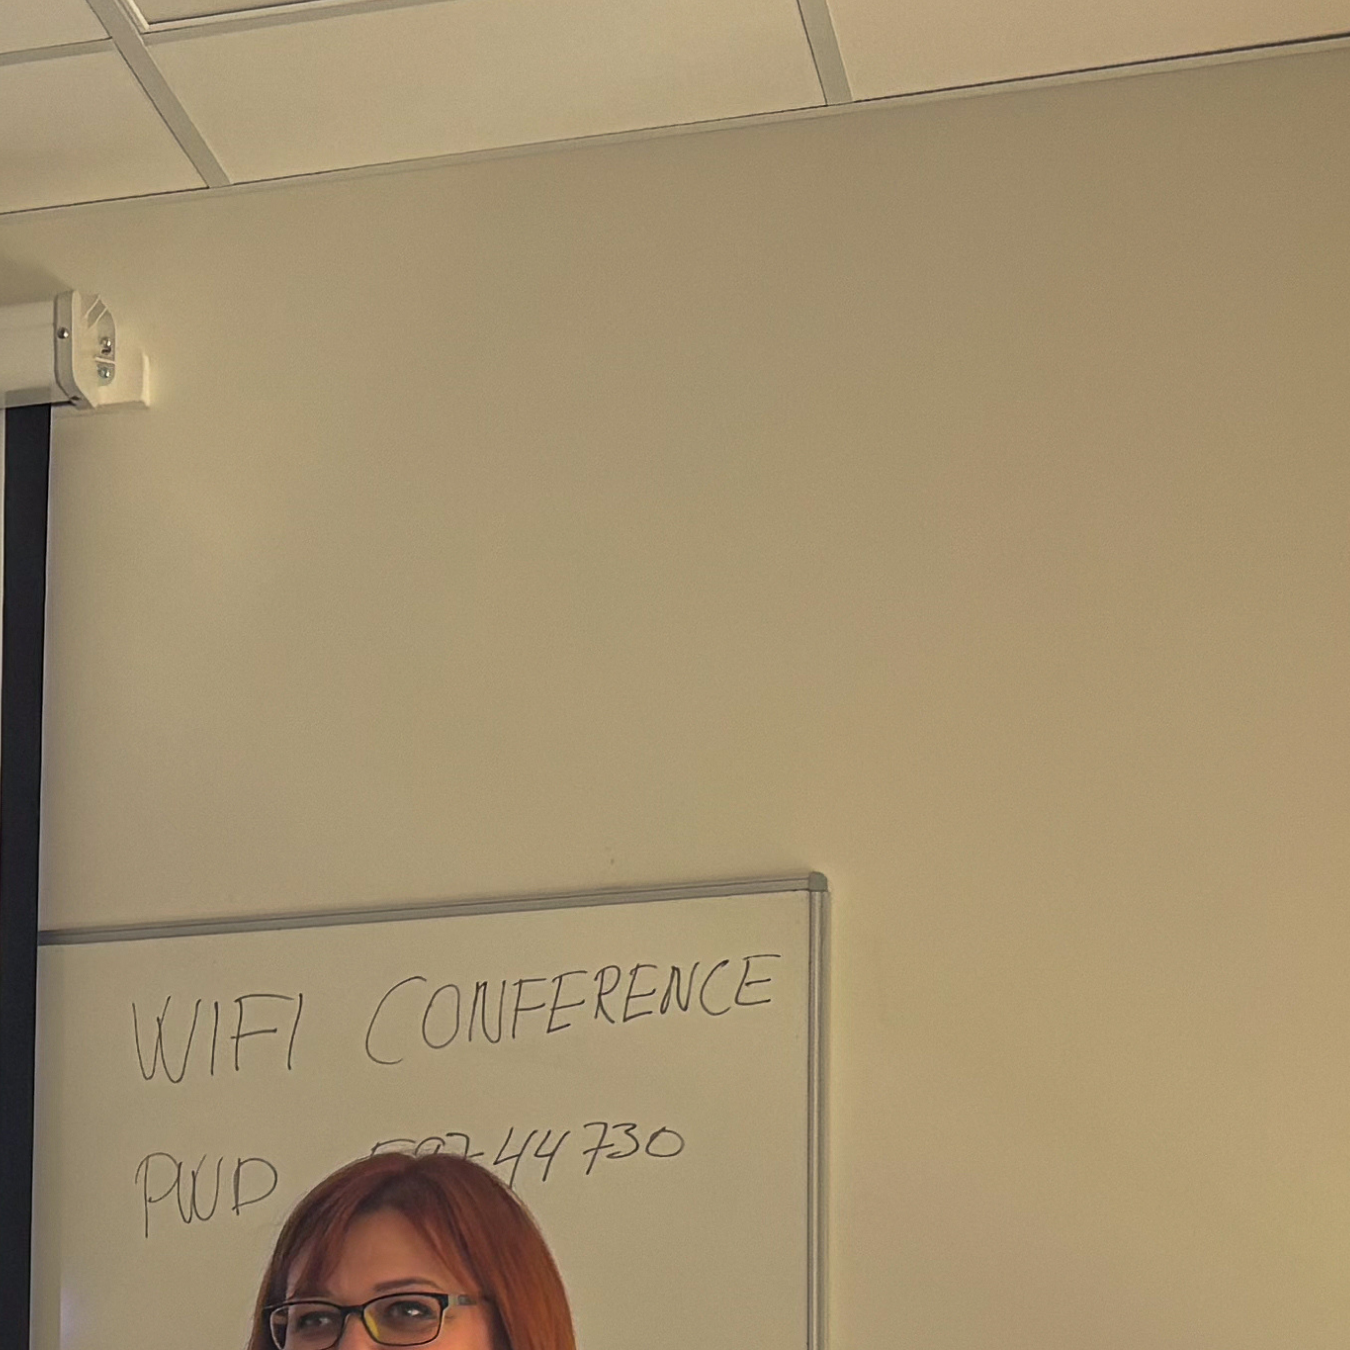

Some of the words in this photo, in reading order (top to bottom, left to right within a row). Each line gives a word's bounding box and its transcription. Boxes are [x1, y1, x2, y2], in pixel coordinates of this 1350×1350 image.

[132, 992, 303, 1083] WIFI
[364, 953, 782, 1065] CONFERENCE
[135, 1151, 278, 1238] PWD
